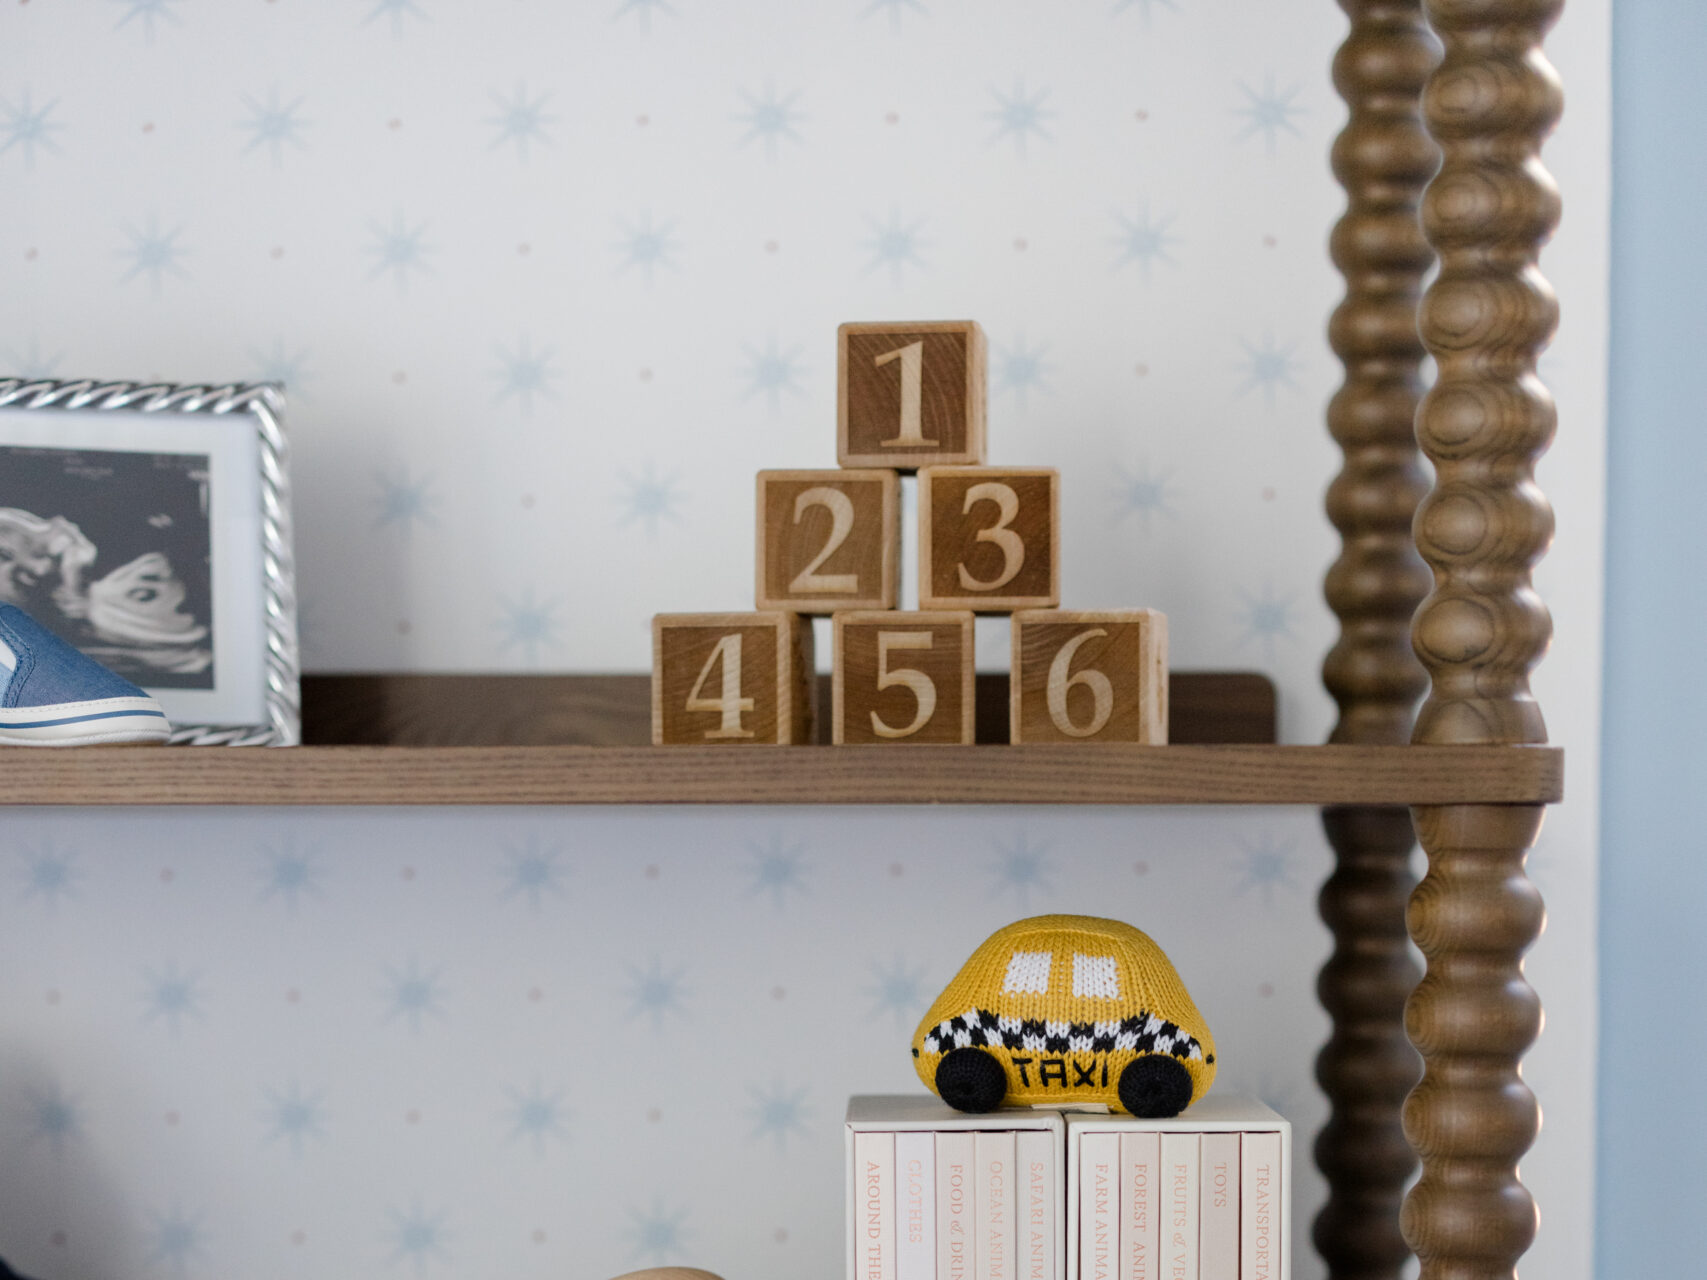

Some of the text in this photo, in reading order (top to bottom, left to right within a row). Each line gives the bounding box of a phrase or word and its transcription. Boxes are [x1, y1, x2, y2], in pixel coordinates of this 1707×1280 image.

[875, 341, 939, 447] 1
[789, 487, 858, 593] 2
[957, 482, 1025, 591] 3
[685, 633, 755, 738] 4
[870, 631, 937, 737] 5
[1047, 628, 1114, 737] 6
[1012, 1058, 1108, 1088] TAXI
[867, 1161, 881, 1239] AROUND
[908, 1159, 922, 1243] CLOTHES
[950, 1164, 963, 1215] FOOD
[989, 1161, 1003, 1224] OCEAN
[1030, 1162, 1044, 1225] SAFARI
[1095, 1164, 1108, 1214] FARM
[1134, 1164, 1147, 1232] FOREST
[1174, 1164, 1187, 1227] FRUITS
[1214, 1162, 1227, 1207] TOYS
[868, 1244, 881, 1280] THE
